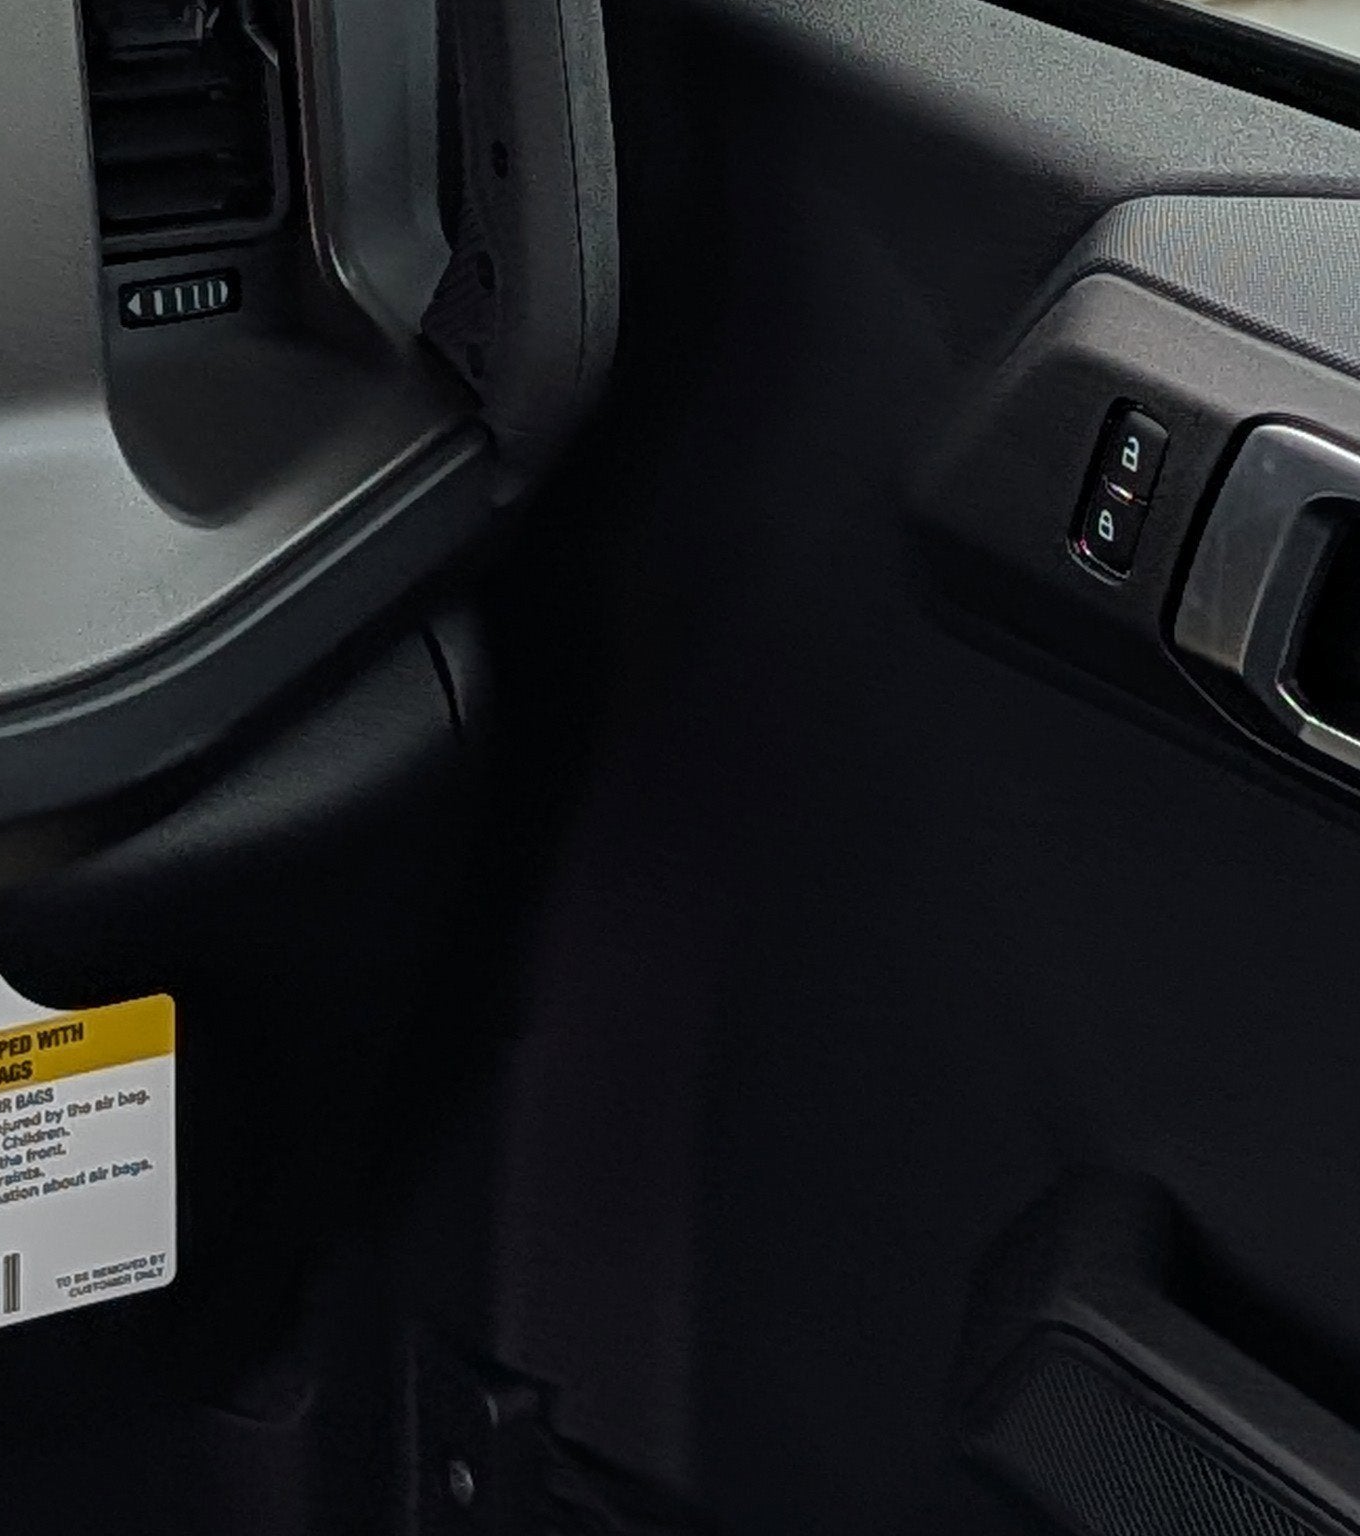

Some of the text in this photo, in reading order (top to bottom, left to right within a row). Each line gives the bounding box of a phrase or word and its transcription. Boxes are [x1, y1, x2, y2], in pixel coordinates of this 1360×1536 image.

[37, 1022, 84, 1051] WITH
[16, 1088, 55, 1110] BAGS
[45, 1107, 64, 1124] by
[68, 1102, 91, 1118] the
[95, 1096, 114, 1112] air
[118, 1089, 150, 1107] bag.
[2, 1126, 70, 1151] Children.
[0, 1153, 23, 1170] the
[26, 1143, 67, 1163] front.
[43, 1171, 85, 1195] about
[89, 1166, 108, 1183] air
[112, 1158, 153, 1177] bags.
